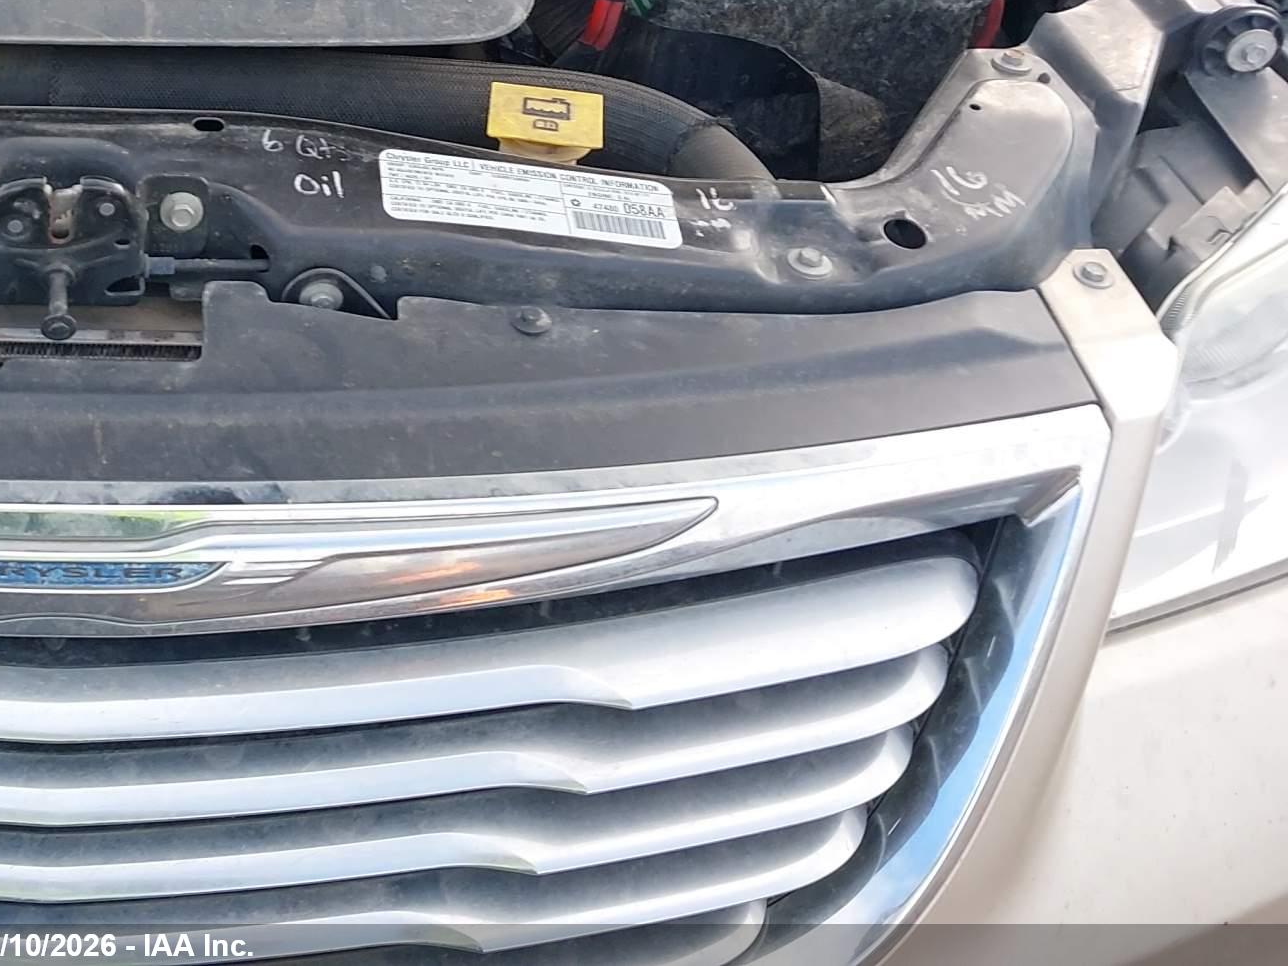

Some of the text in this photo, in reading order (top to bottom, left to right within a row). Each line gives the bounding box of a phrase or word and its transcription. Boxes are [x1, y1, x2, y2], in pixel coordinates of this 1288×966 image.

[261, 129, 284, 152] 6
[294, 170, 345, 199] Oil
[385, 152, 422, 163] Chrysler
[424, 156, 450, 167] Group
[453, 160, 471, 168] LLC
[479, 163, 514, 173] VEHICLE
[517, 168, 558, 179] EMISSION
[560, 173, 598, 185] CONTROL
[601, 178, 659, 192] INFORMATION
